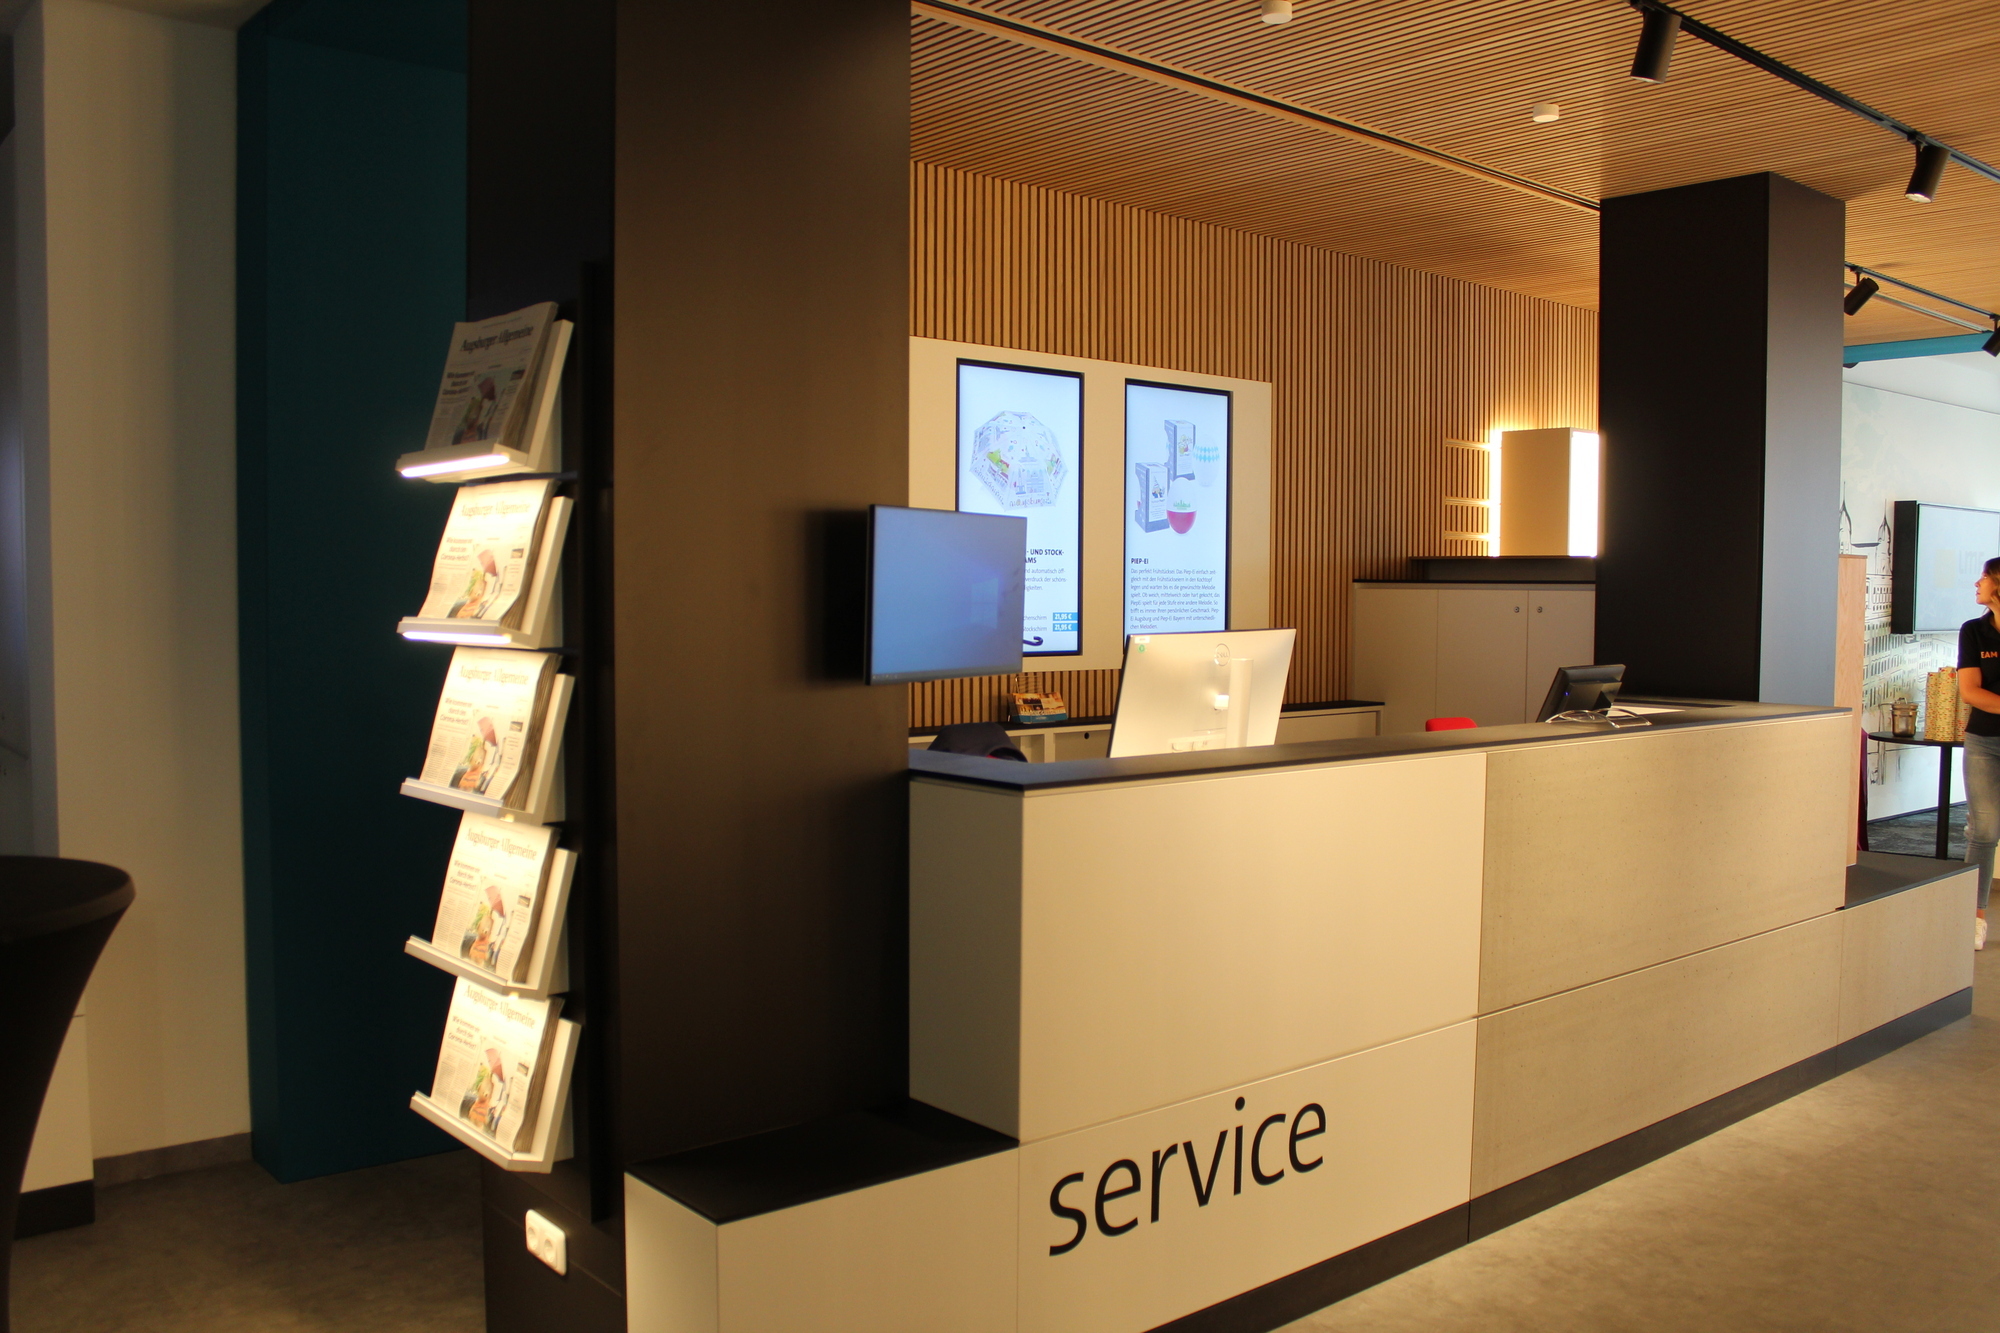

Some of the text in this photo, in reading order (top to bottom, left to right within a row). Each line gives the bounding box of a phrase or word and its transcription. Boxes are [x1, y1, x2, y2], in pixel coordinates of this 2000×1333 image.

[460, 326, 534, 354] Augsburger Allgemeine
[461, 500, 530, 519] Augsburger Allgemeine
[1981, 651, 1998, 659] EAM
[460, 665, 529, 686] Augsburger Allgemeine
[467, 828, 538, 861] Augsburger Allgemeine
[464, 985, 536, 1029] Augsburger Allgemeine
[1049, 1096, 1326, 1257] service
